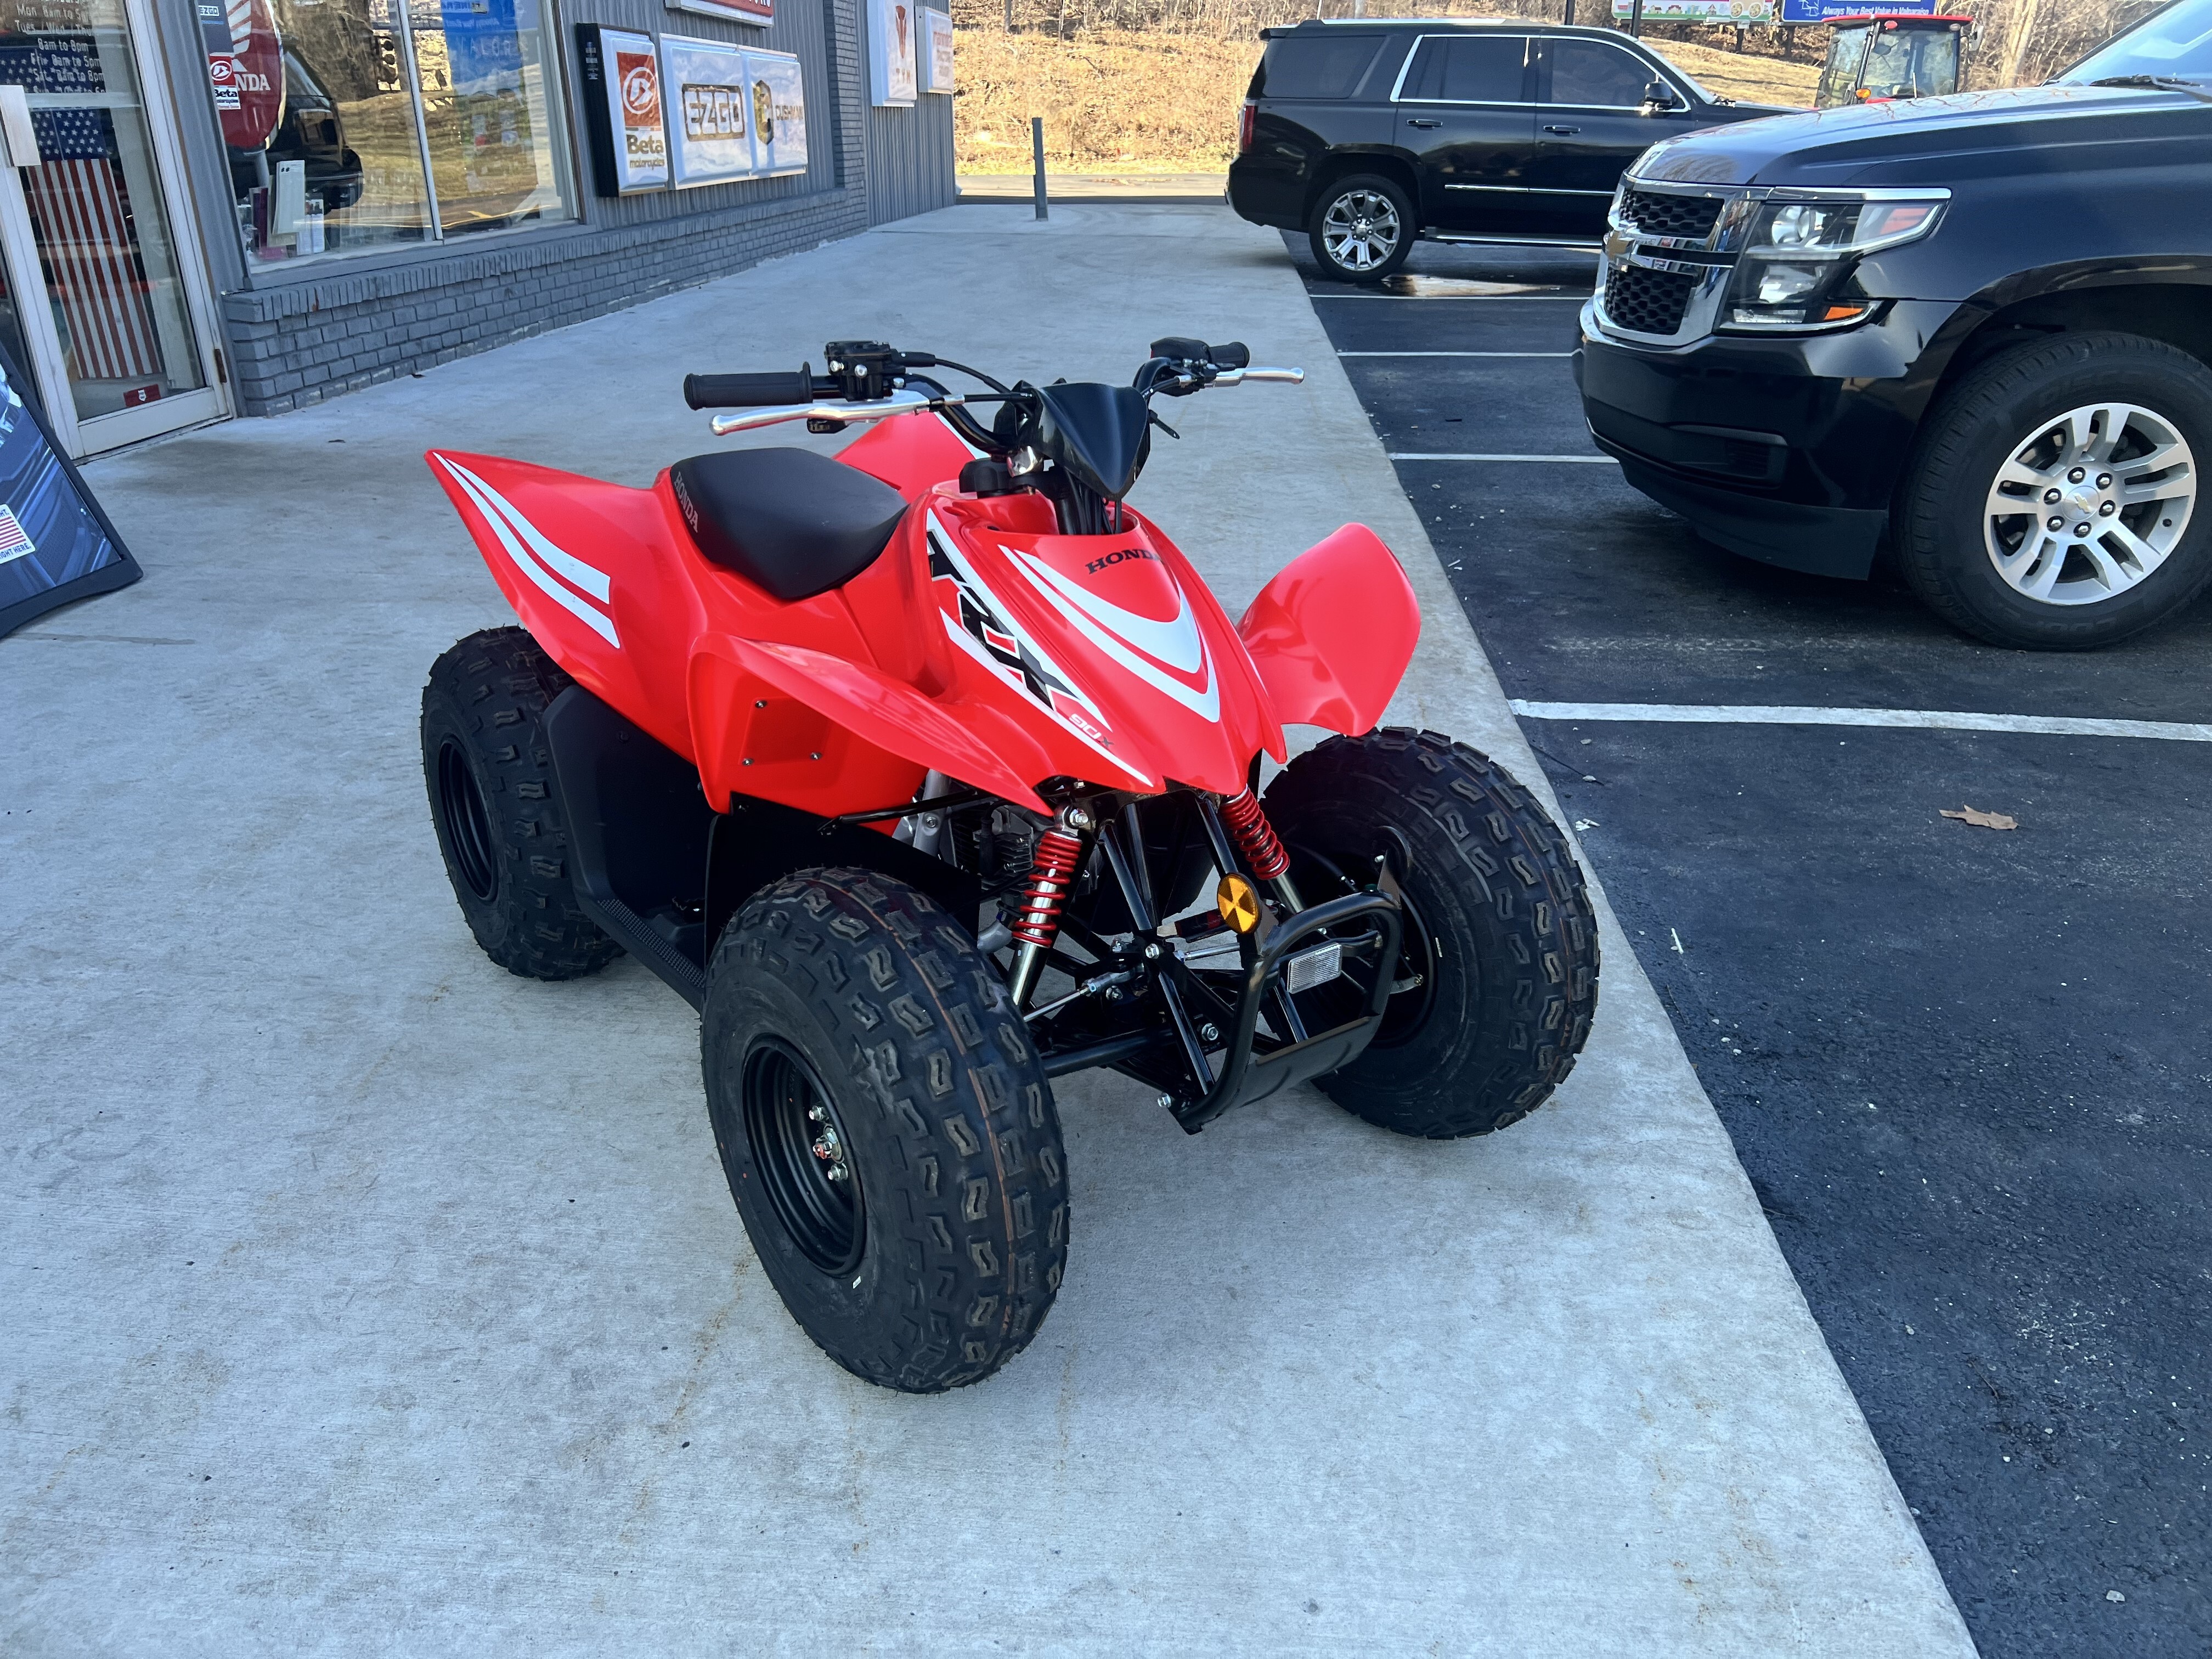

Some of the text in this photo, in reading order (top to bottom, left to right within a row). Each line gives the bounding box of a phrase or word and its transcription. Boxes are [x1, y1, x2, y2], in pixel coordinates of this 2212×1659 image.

[16, 4, 37, 17] Mon
[1822, 7, 1844, 16] Always
[1846, 7, 1859, 15] Your
[37, 37, 58, 50] 8am
[58, 39, 69, 52] to
[234, 74, 271, 91] NDA
[627, 134, 664, 154] Beta
[674, 471, 698, 533] HONDA
[13, 543, 32, 554] HERE.
